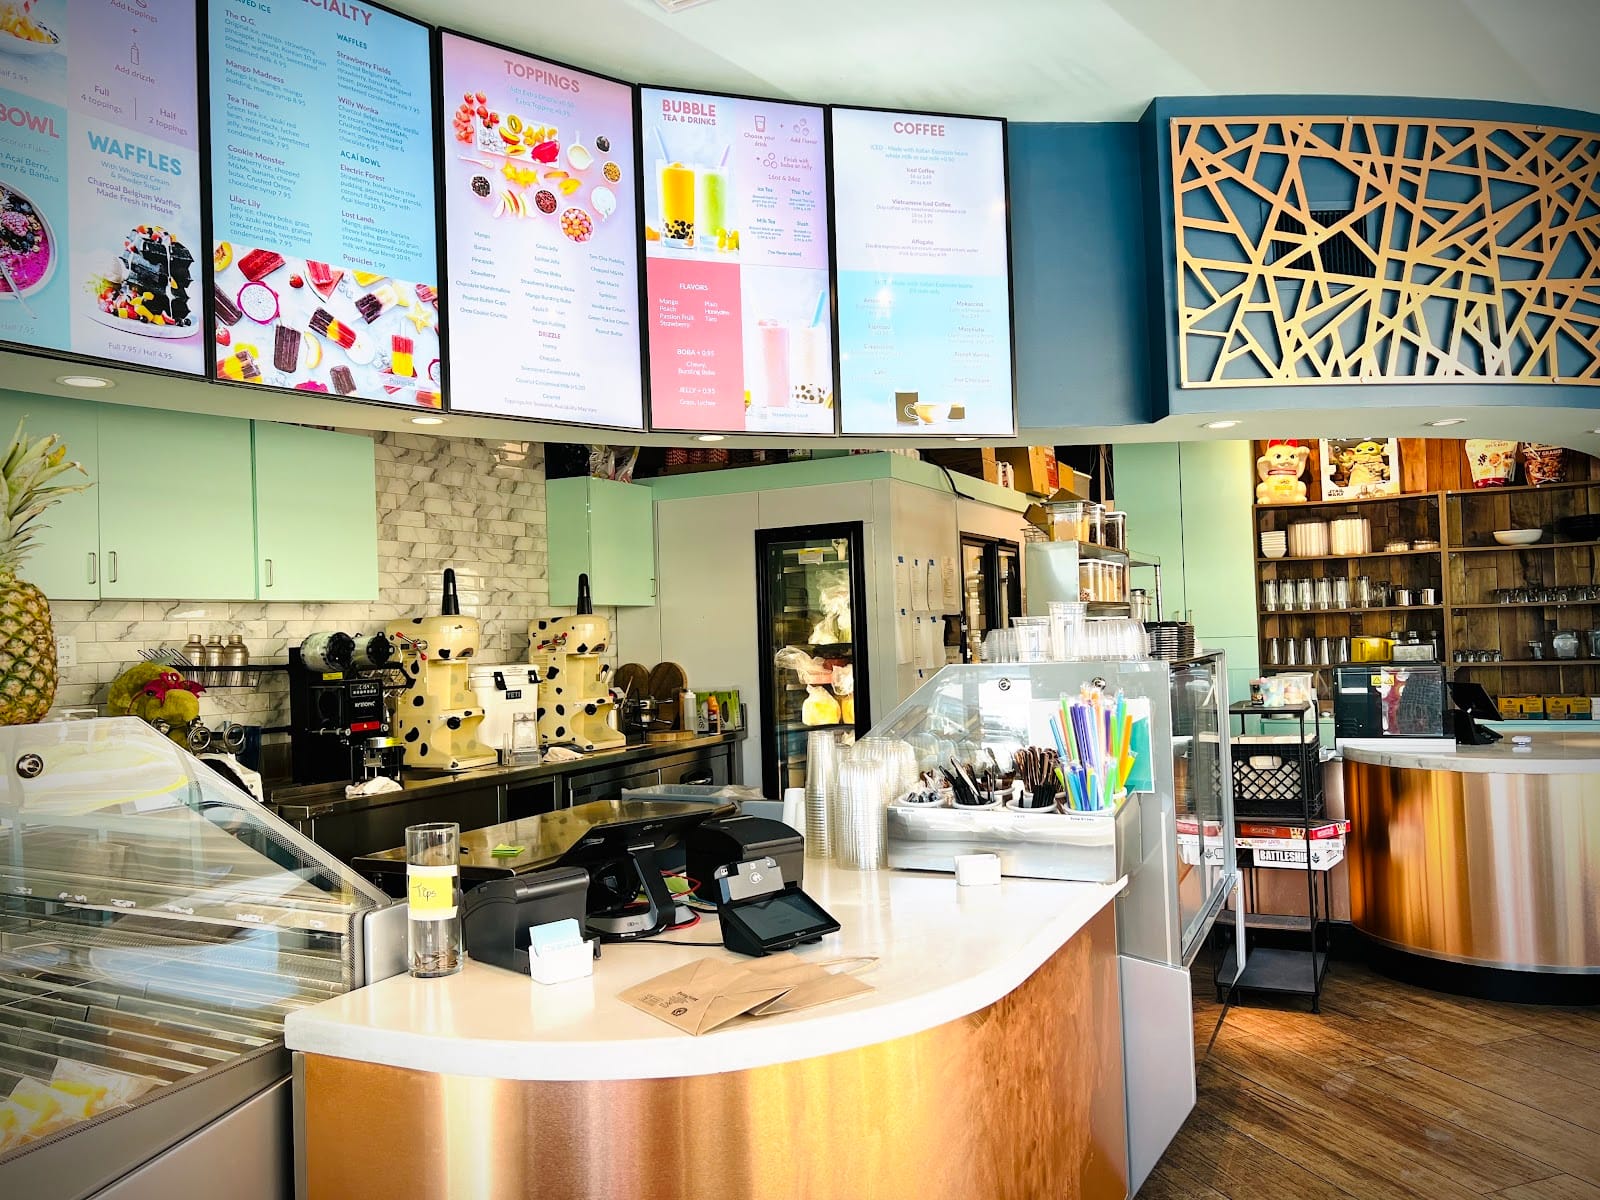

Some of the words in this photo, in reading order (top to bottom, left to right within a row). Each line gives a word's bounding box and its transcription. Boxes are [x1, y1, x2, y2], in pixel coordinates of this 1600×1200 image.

[128, 6, 158, 22] toppings
[225, 10, 238, 20] The
[258, 4, 272, 14] ICE
[336, 32, 367, 50] WAFFLES
[225, 58, 251, 74] Mango
[252, 67, 284, 84] Madness
[336, 50, 372, 70] Strawberry
[372, 64, 392, 76] Fields
[115, 64, 130, 75] Add
[132, 70, 155, 84] drizzle
[504, 60, 580, 93] TOPPINGS
[94, 85, 110, 96] Full
[88, 96, 122, 114] toppings
[226, 94, 240, 104] Tea
[242, 98, 260, 110] Time
[337, 96, 354, 108] Willy
[356, 102, 379, 116] Wonka
[662, 98, 716, 118] BUBBLE
[160, 108, 176, 120] Half
[662, 114, 678, 122] TEA
[688, 116, 717, 126] DRINKS
[148, 116, 154, 124] 2
[156, 119, 188, 136] toppings
[893, 121, 945, 137] COFFEE
[87, 130, 182, 176] WAFFLES
[227, 144, 254, 158] Cookie
[255, 152, 286, 166] Monster
[360, 156, 381, 168] BOWL
[29, 168, 60, 184] Banana
[340, 164, 364, 176] Electric
[366, 170, 385, 182] Forest
[87, 176, 120, 192] Charcoal
[122, 186, 152, 201] Belgium
[154, 196, 182, 210] Waffles
[97, 188, 118, 200] Made
[120, 194, 140, 206] Fresh
[142, 199, 149, 208] in
[150, 203, 174, 216] House
[230, 194, 246, 205] Lilac
[248, 199, 260, 209] Lily
[342, 209, 355, 220] Lost
[356, 214, 374, 224] Lands
[343, 253, 373, 266] Popsicles
[679, 282, 709, 292] FLAVORS
[659, 298, 679, 306] Mango
[538, 330, 561, 340] DRIZZLE
[108, 342, 120, 350] Full
[676, 348, 695, 356] BOBA
[506, 690, 521, 699] YETI
[411, 882, 437, 902] Tips
